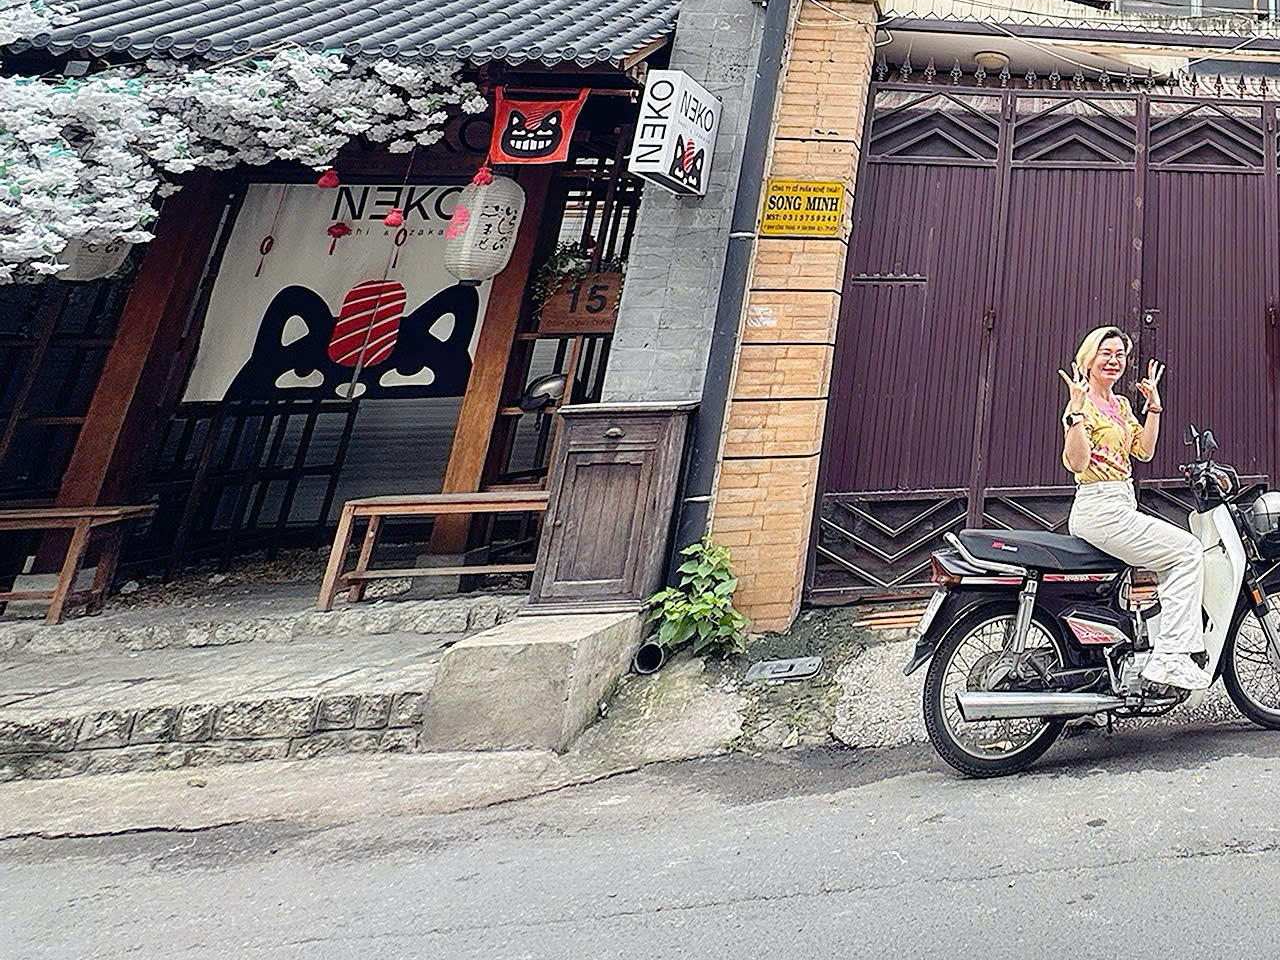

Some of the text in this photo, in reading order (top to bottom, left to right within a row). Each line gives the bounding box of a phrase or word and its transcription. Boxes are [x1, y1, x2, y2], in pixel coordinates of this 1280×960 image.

[635, 80, 674, 163] NEKO
[680, 90, 714, 133] NEKO
[768, 195, 839, 211] SONG MINH
[567, 283, 610, 314] 15
